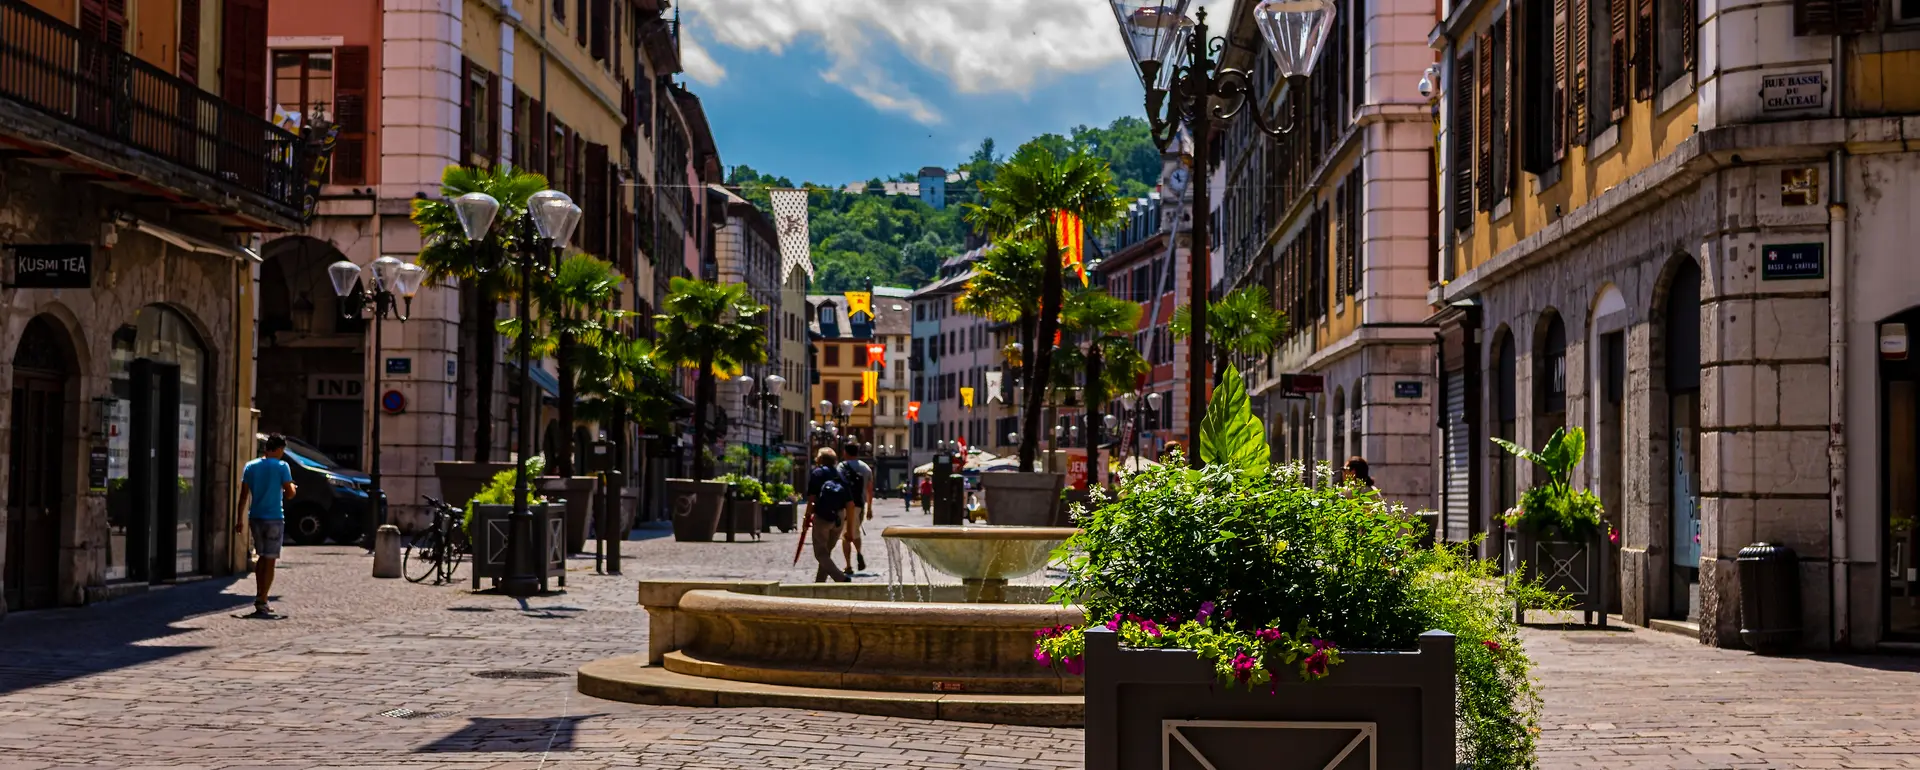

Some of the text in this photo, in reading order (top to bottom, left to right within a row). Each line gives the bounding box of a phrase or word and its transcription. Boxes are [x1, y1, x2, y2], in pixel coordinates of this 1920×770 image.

[1764, 76, 1820, 88] RUE BASSE
[1786, 87, 1799, 95] DU
[1768, 94, 1817, 107] CHÂTEAU
[18, 255, 86, 274] KUSMI TEA
[1767, 263, 1784, 271] BASSE
[1794, 262, 1818, 270] CHÂTEAU
[317, 379, 362, 396] IND
